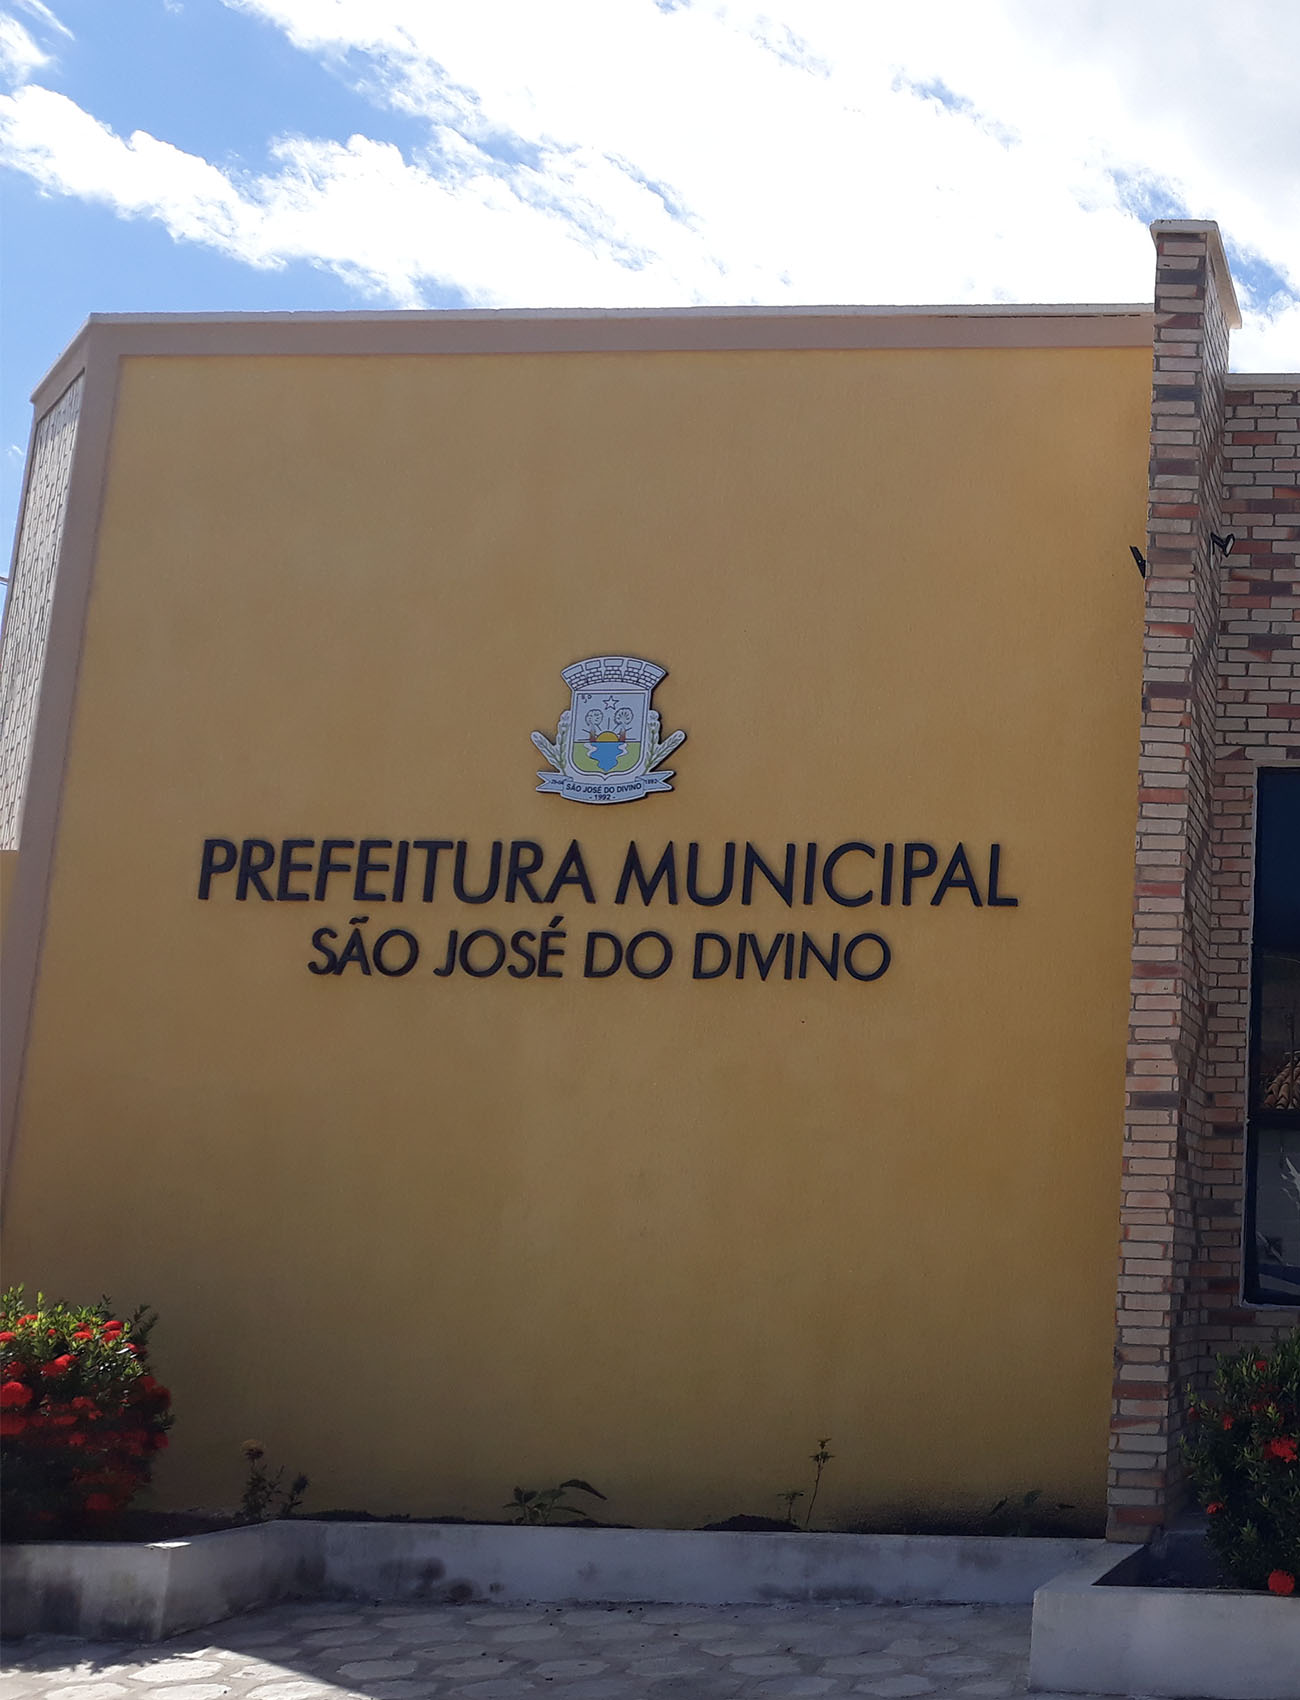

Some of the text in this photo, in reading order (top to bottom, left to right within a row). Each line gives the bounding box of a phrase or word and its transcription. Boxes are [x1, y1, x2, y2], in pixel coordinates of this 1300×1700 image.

[604, 785, 615, 794] DO
[617, 783, 642, 793] DIVINO
[198, 838, 1020, 909] PREFEITURA MUNICIPAL
[308, 915, 892, 983] SÃO JOSÉ DO DIVINO
